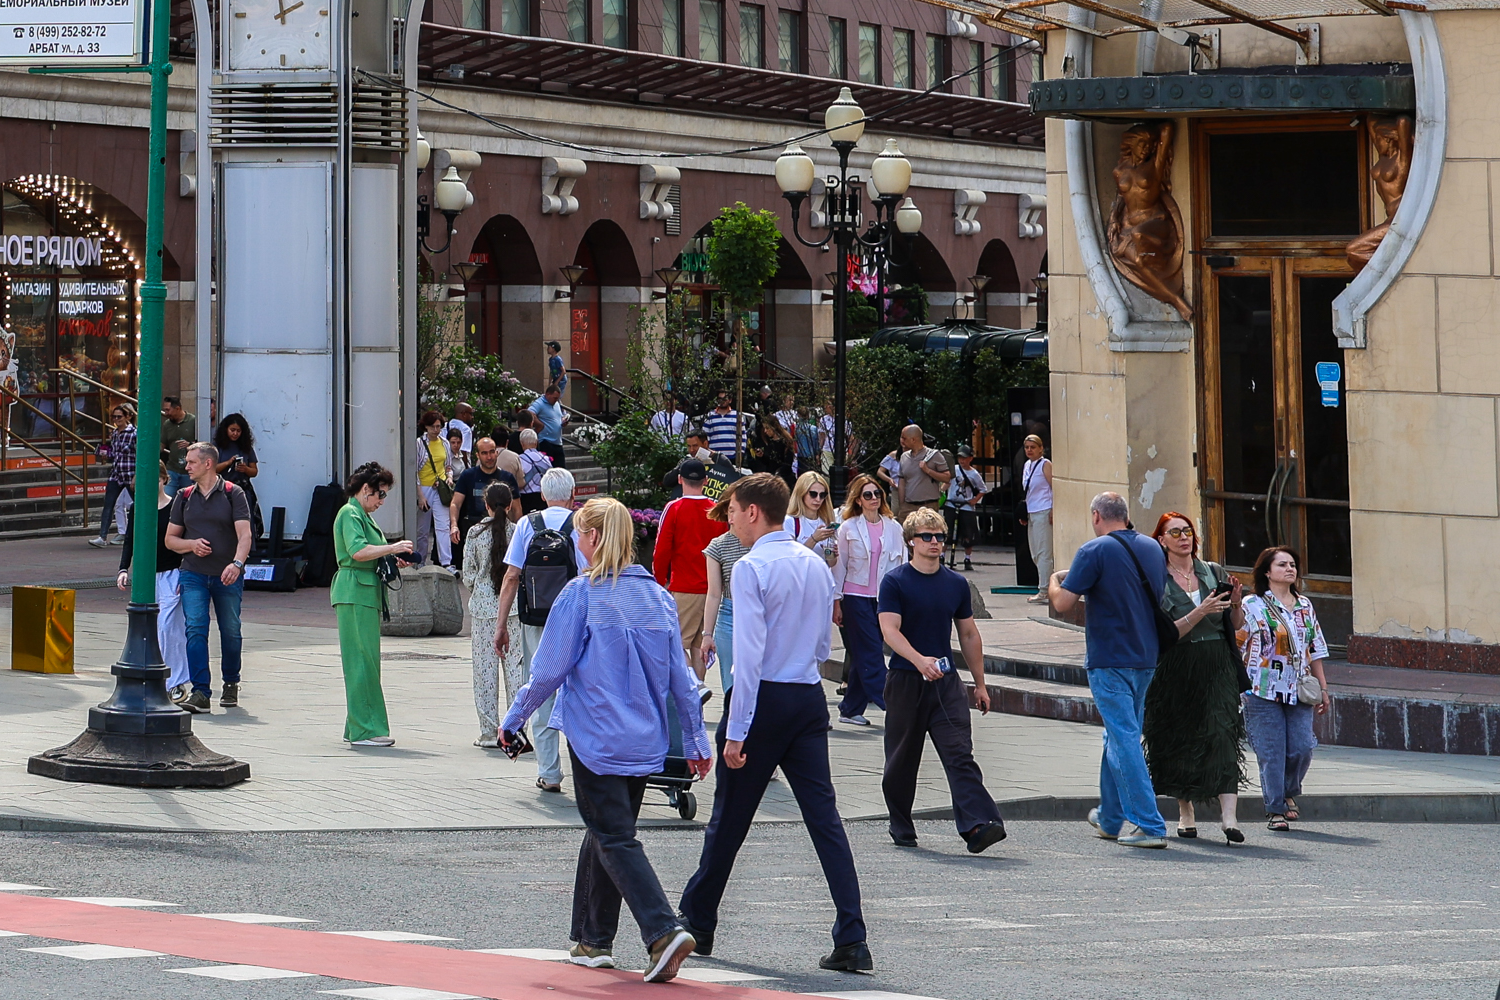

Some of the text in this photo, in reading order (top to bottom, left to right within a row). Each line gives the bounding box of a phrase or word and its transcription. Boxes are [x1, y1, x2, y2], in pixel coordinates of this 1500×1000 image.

[29, 25, 106, 40] 8 (499) 252-82-72
[29, 43, 59, 54] АРБАТ
[87, 42, 100, 53] 33
[37, 236, 101, 269] РЯДОМ
[12, 282, 125, 297] МАГАЗИН УДИВИТЕЛЬНЫХ
[59, 300, 103, 315] ПОДАРКОВ
